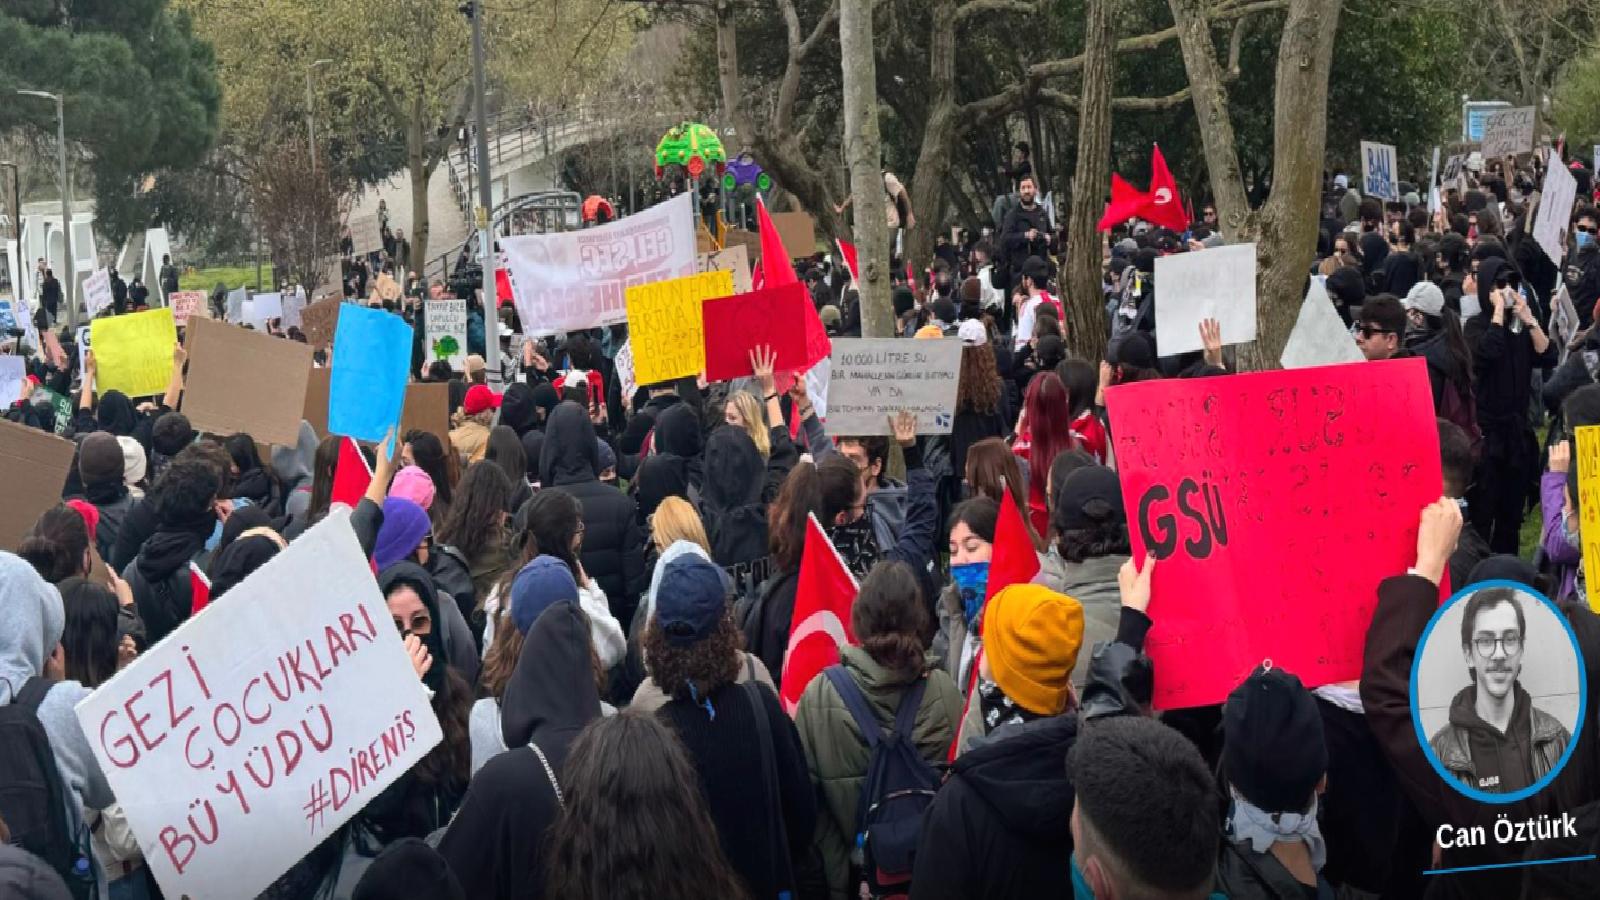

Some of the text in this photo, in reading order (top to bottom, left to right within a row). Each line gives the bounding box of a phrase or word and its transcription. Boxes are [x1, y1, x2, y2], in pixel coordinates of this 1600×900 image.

[914, 352, 926, 363] SU
[1138, 470, 1228, 560] GSÜ
[100, 645, 212, 769] GEZİ
[184, 603, 378, 771] ÇOCUKLARI
[158, 702, 334, 875] BÜYÜDÜ
[303, 709, 416, 836] #DİRENİŞ
